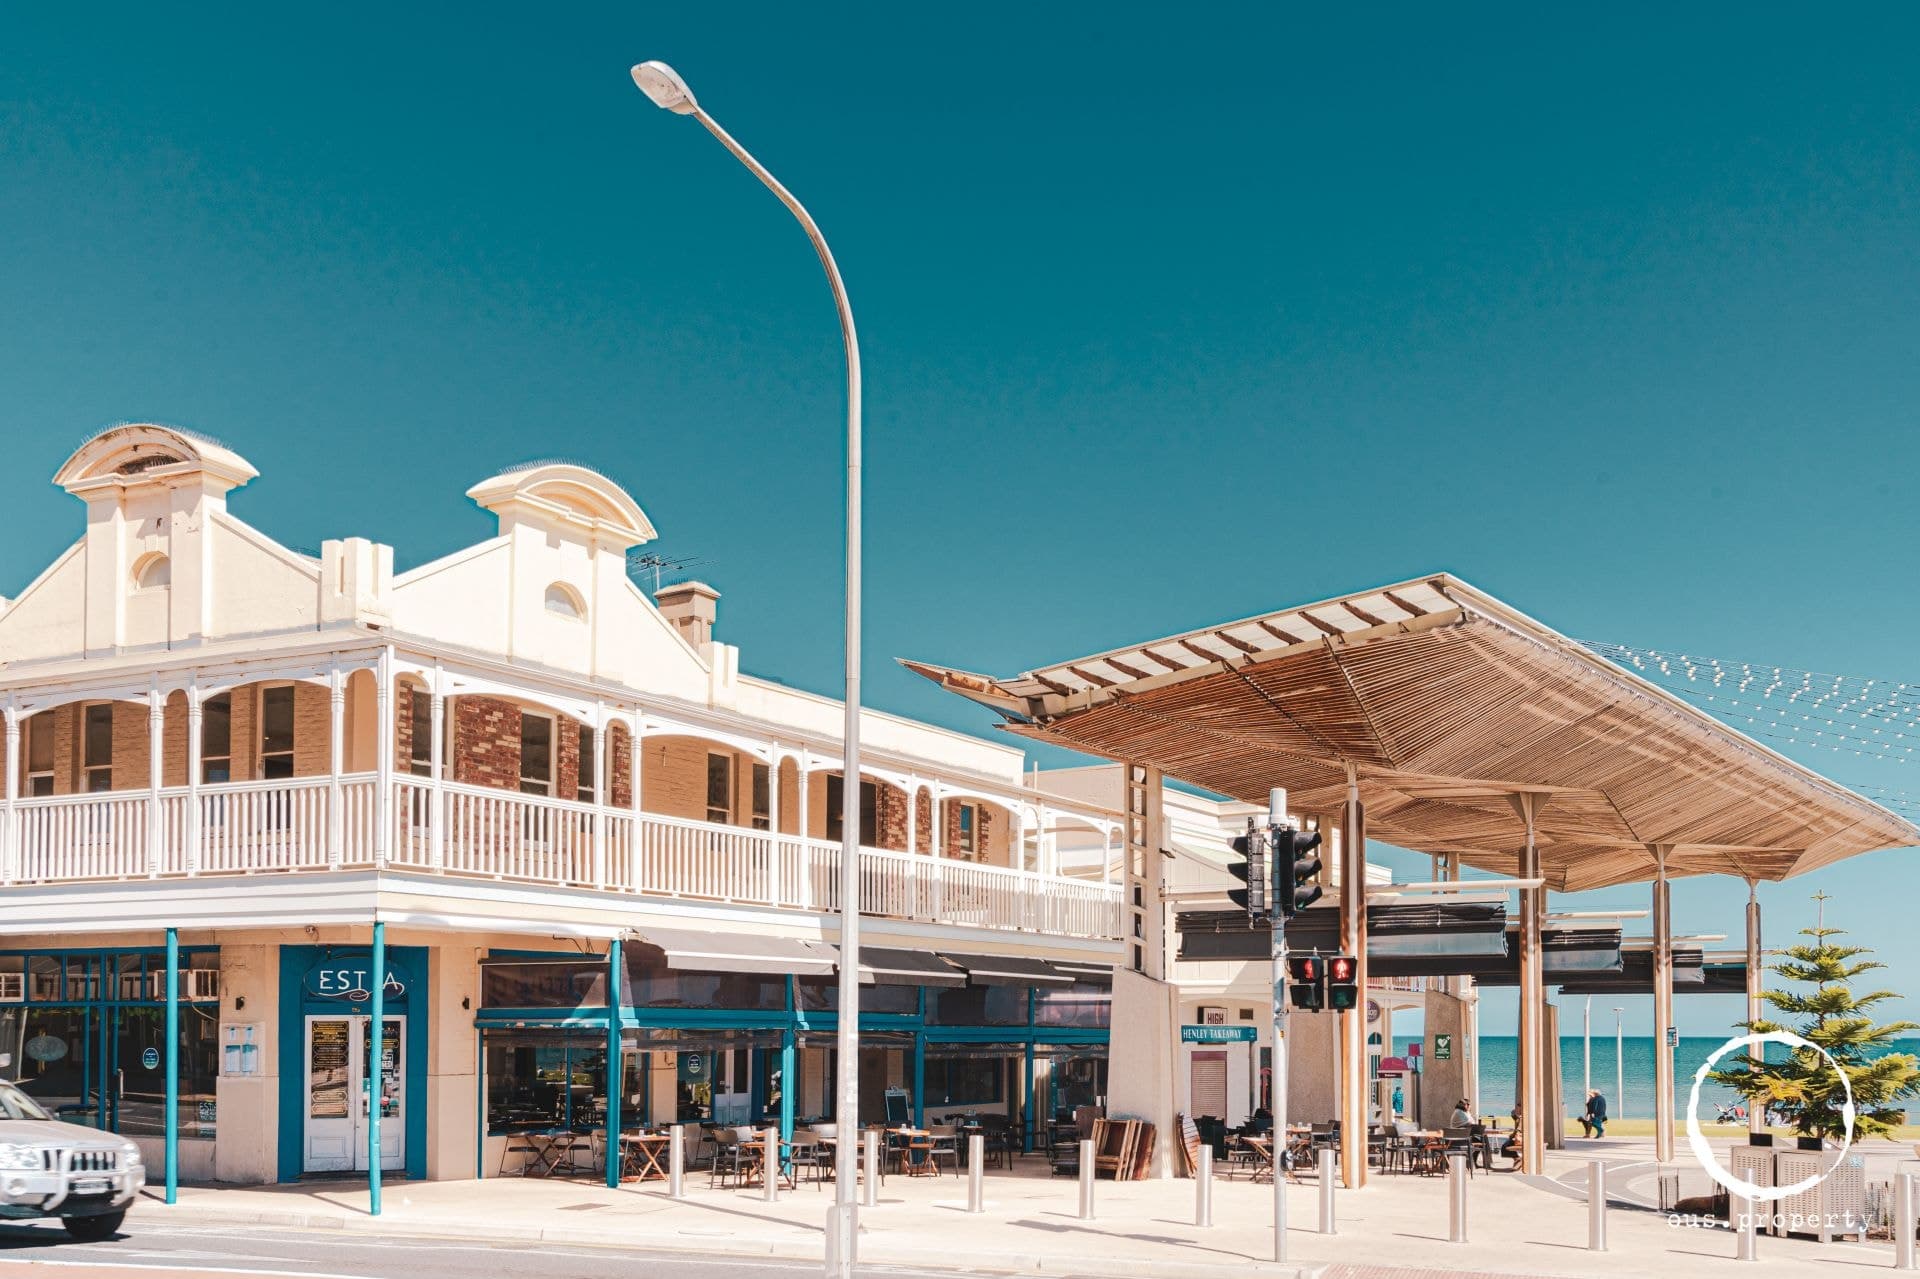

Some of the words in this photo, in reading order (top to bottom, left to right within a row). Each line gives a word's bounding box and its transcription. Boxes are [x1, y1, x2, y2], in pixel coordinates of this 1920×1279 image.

[319, 970, 399, 990] ESTA
[1207, 1012, 1224, 1024] HIGH
[1183, 1028, 1208, 1039] HENLEY
[1210, 1029, 1242, 1039] TAKEAWAY
